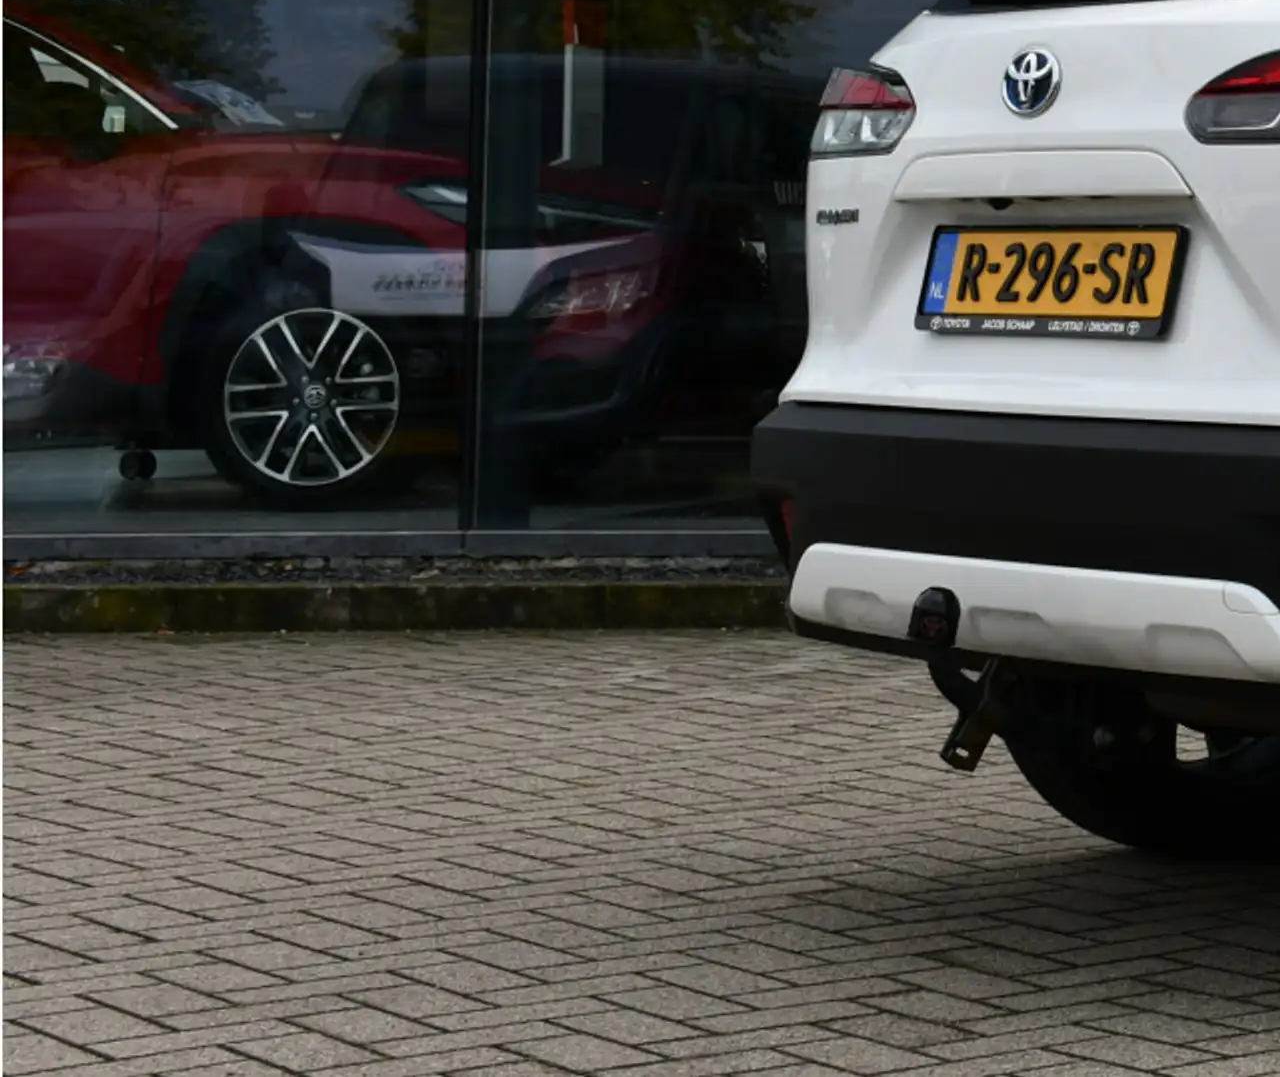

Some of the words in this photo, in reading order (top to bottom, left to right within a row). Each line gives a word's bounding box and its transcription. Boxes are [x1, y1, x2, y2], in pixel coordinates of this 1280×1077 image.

[956, 242, 1156, 304] R-296-SR
[930, 283, 944, 299] NL
[943, 319, 970, 329] TOYOTA
